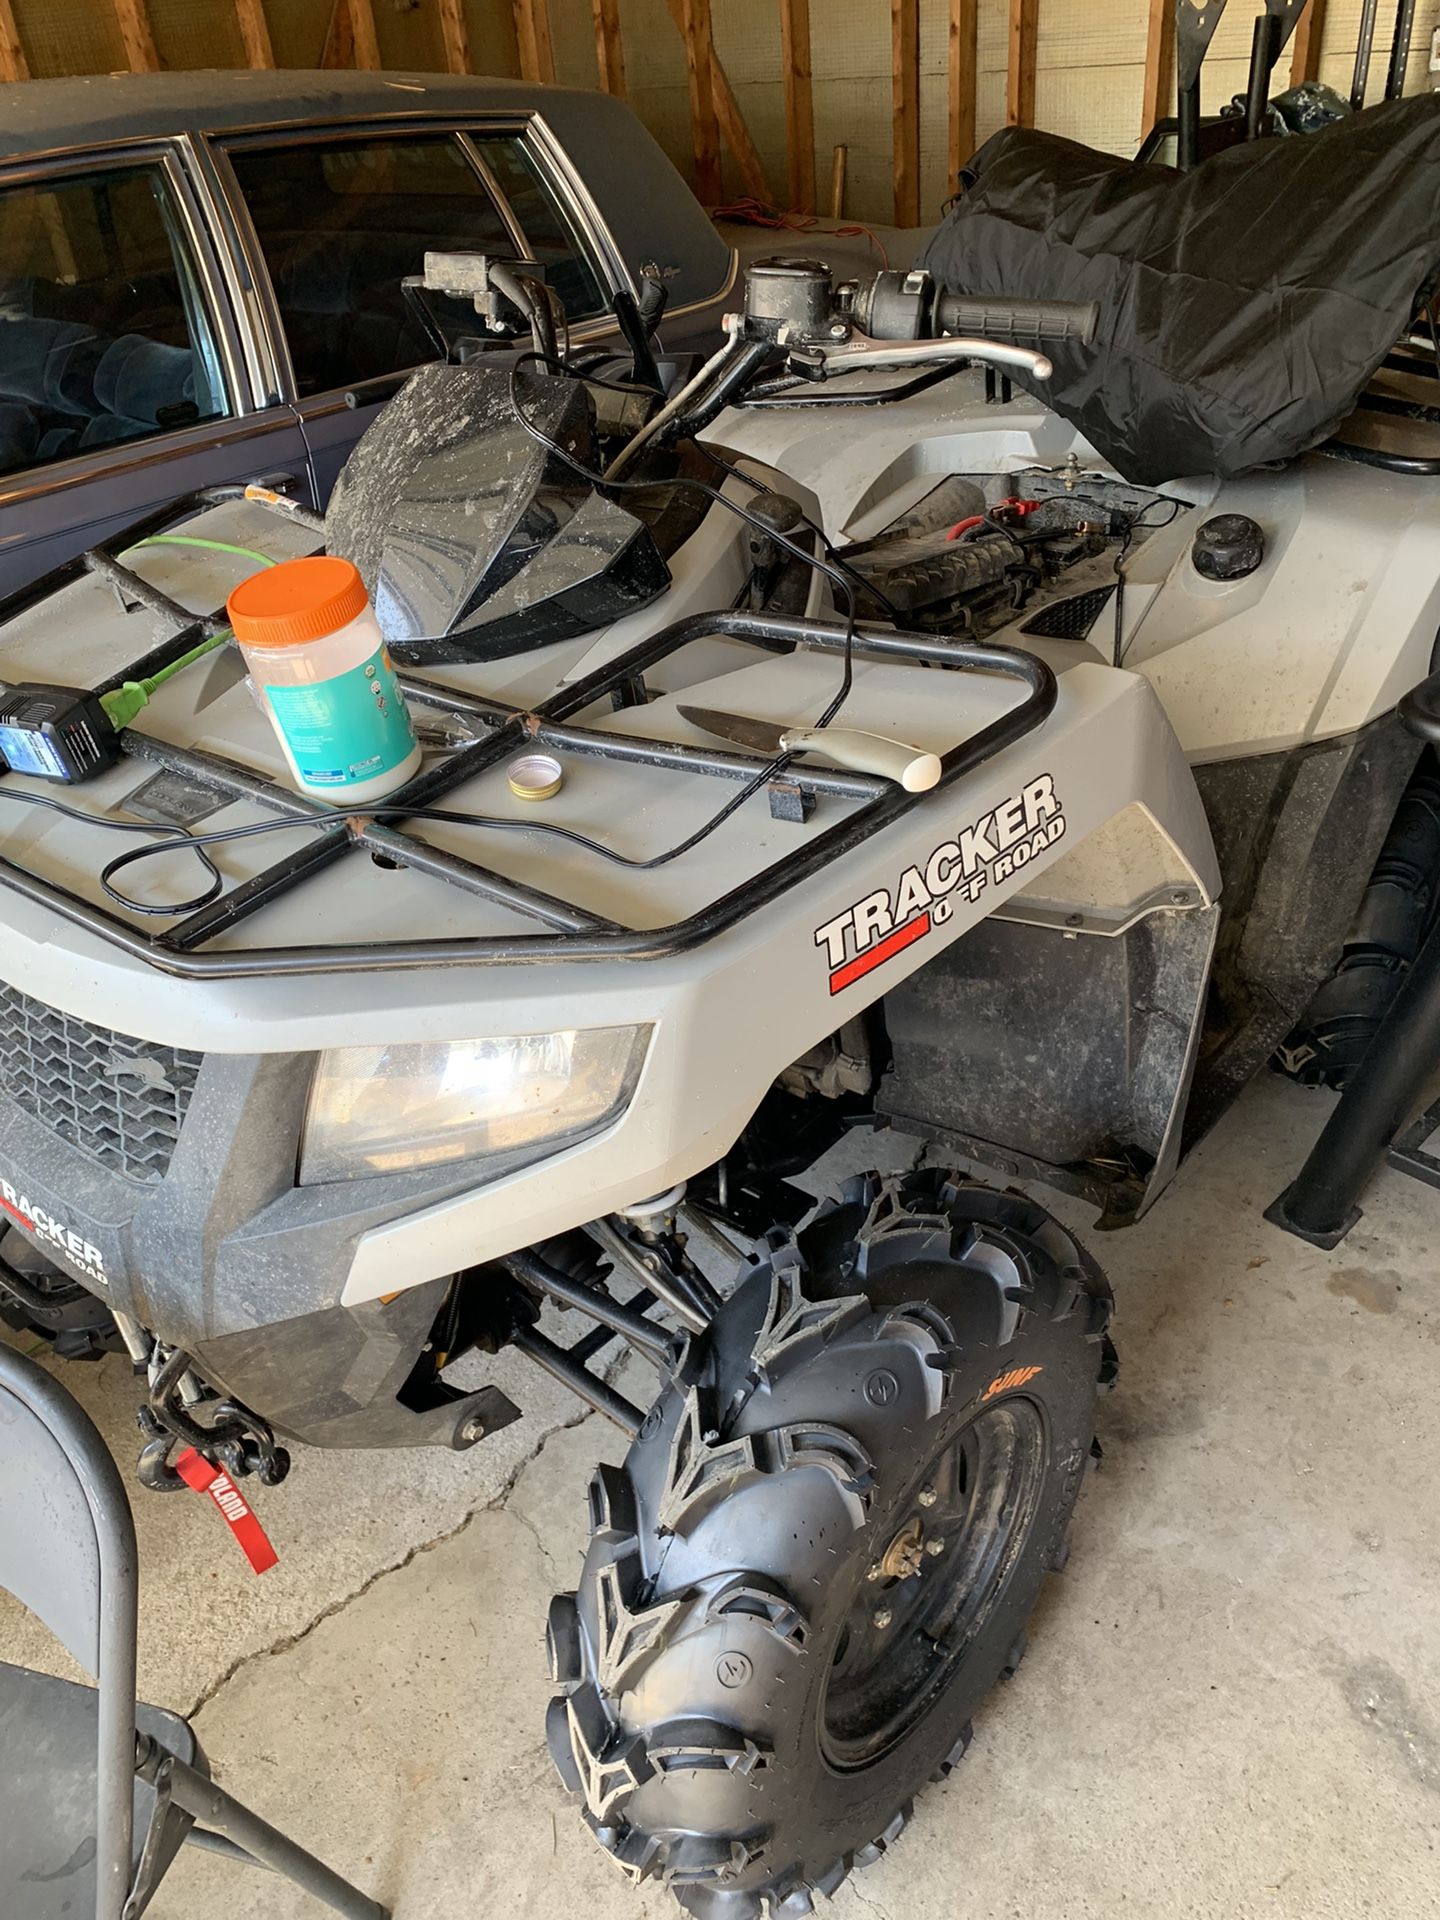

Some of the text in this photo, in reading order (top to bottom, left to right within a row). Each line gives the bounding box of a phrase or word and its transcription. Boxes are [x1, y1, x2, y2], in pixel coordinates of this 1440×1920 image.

[814, 773, 1060, 970] TRACKER
[993, 815, 1066, 885] ROAD
[0, 1178, 104, 1273] RACKER
[64, 1249, 109, 1285] ROAD
